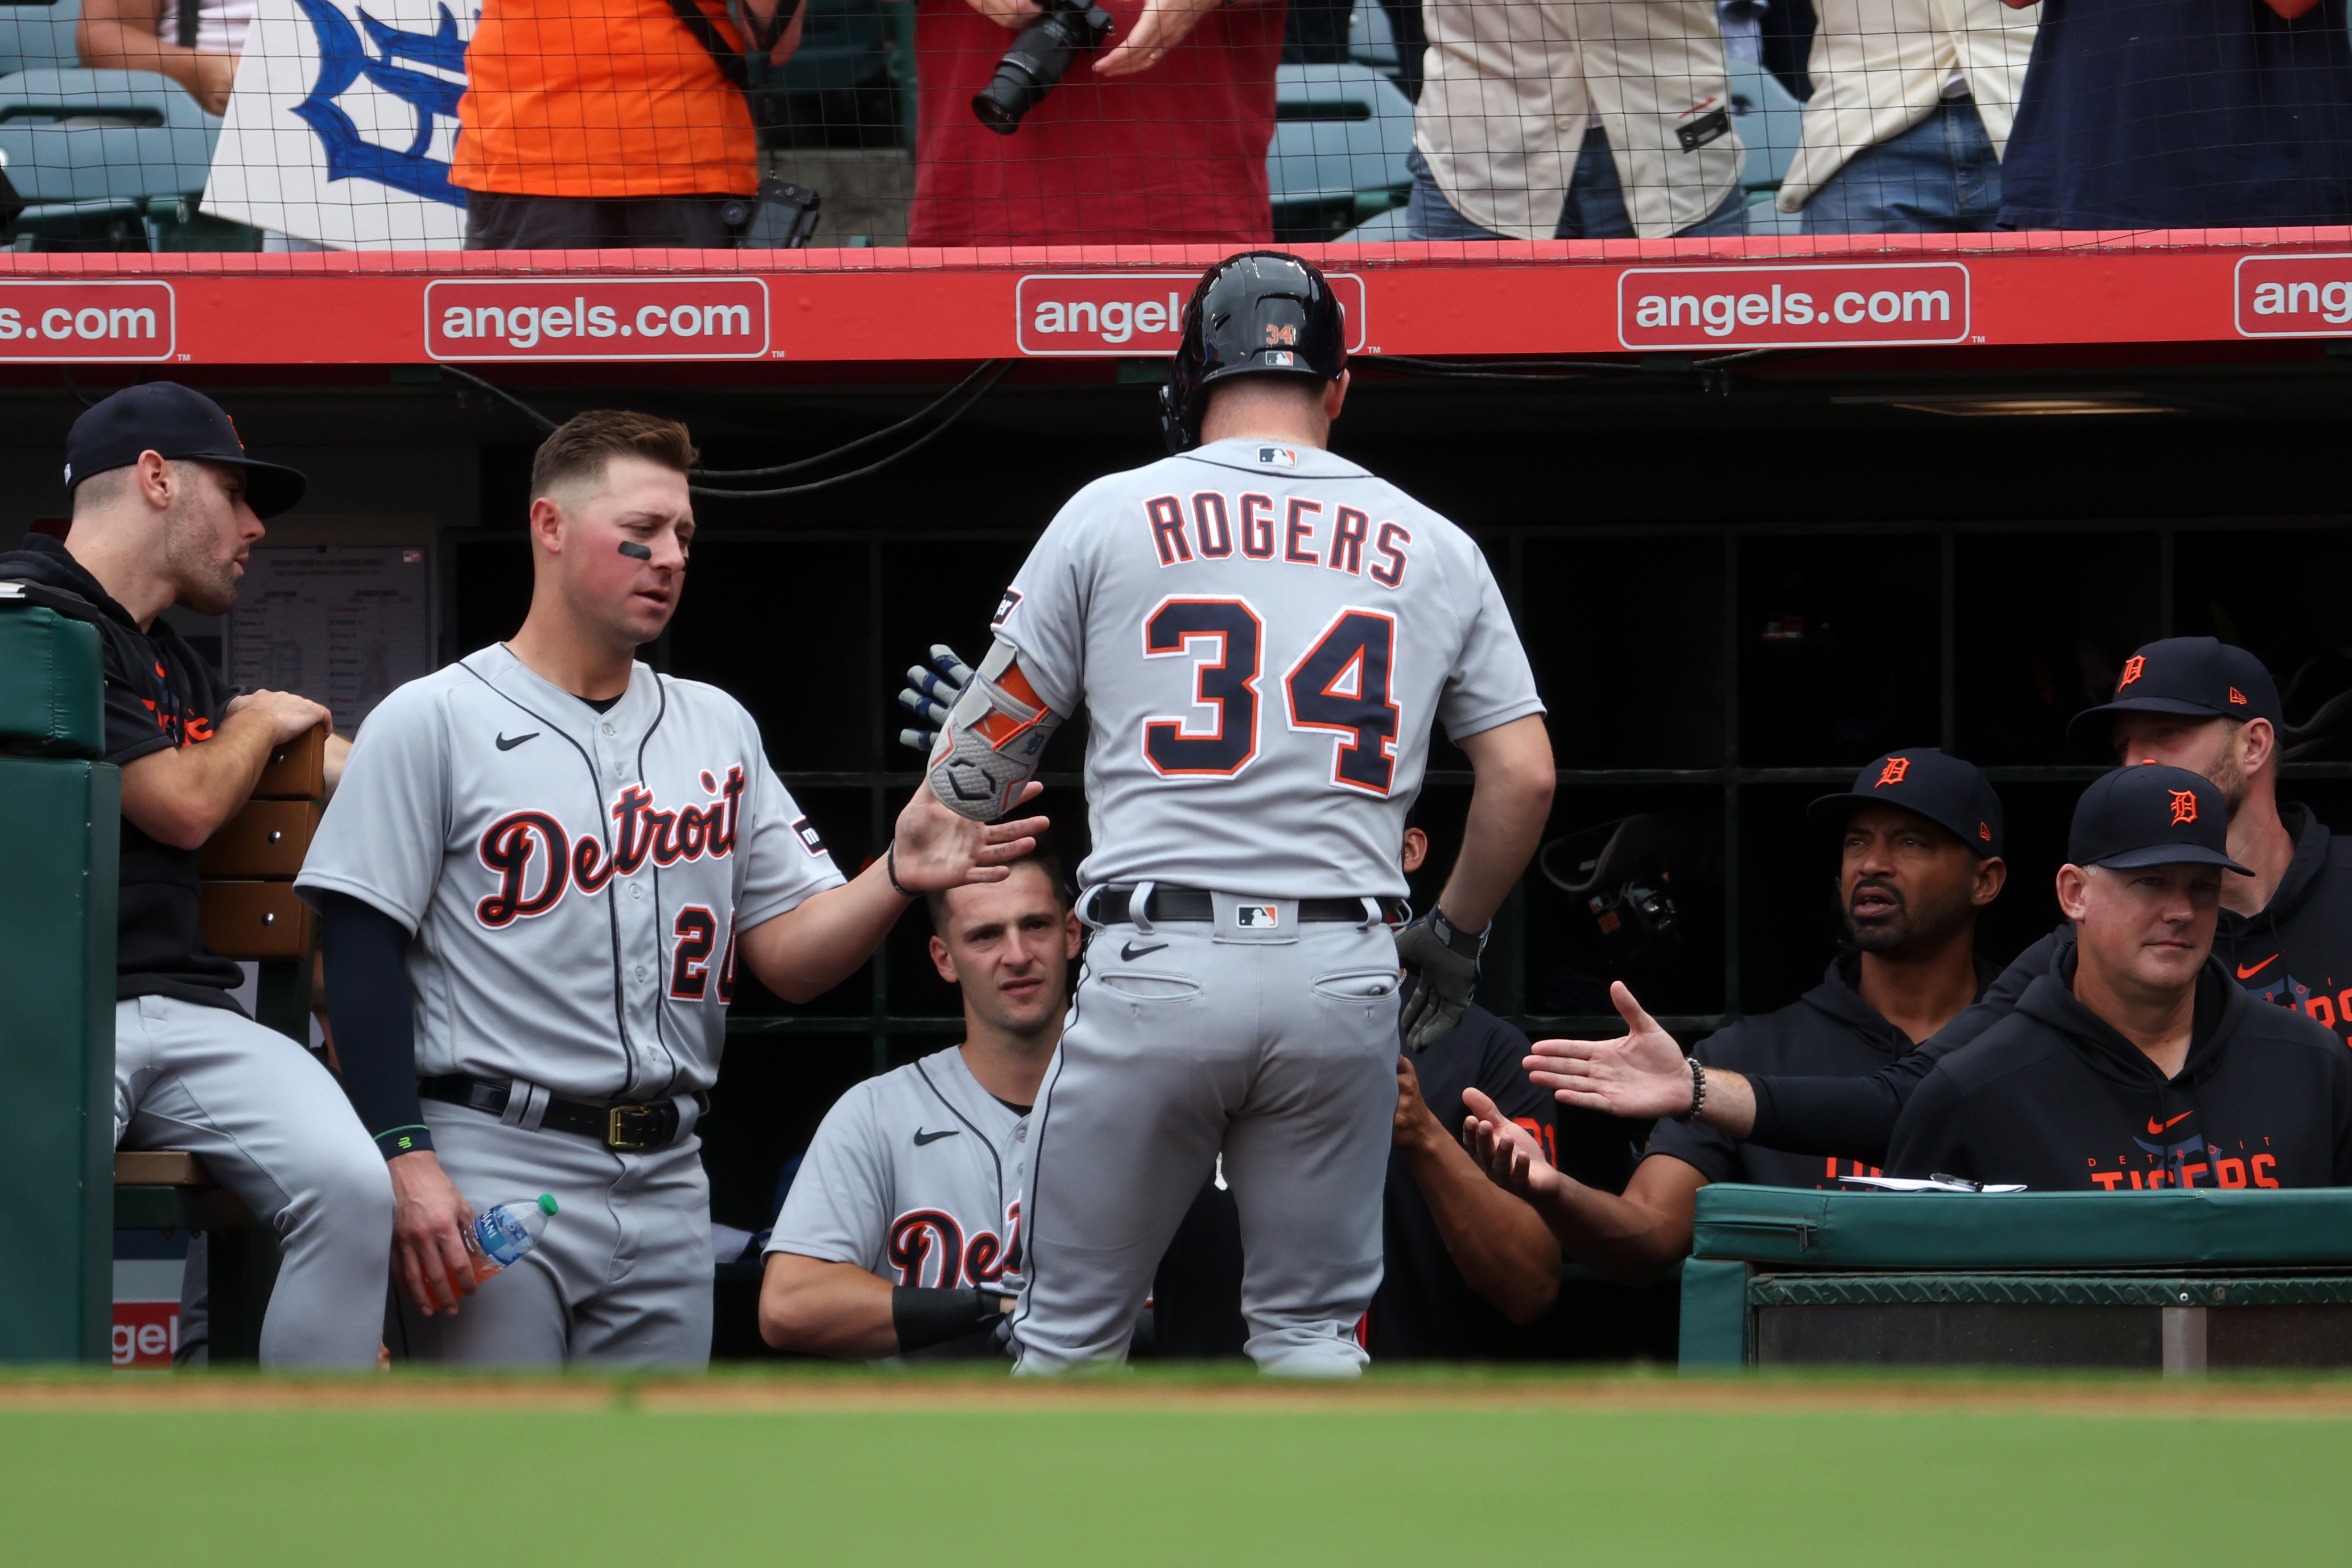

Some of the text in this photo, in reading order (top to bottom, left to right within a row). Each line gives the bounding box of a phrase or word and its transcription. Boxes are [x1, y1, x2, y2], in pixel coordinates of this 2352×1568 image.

[442, 296, 750, 348] angels.com
[1034, 292, 1187, 343] angel
[1636, 284, 1950, 336] angels.com
[2253, 281, 2352, 323] ang
[1266, 325, 1294, 345] 34
[1141, 489, 1413, 589] ROGERS
[1141, 593, 1402, 799] 34
[1875, 757, 1911, 789] D
[2168, 789, 2198, 826] D
[474, 762, 745, 930] Detroit
[2087, 1137, 2270, 1167] DETROIT
